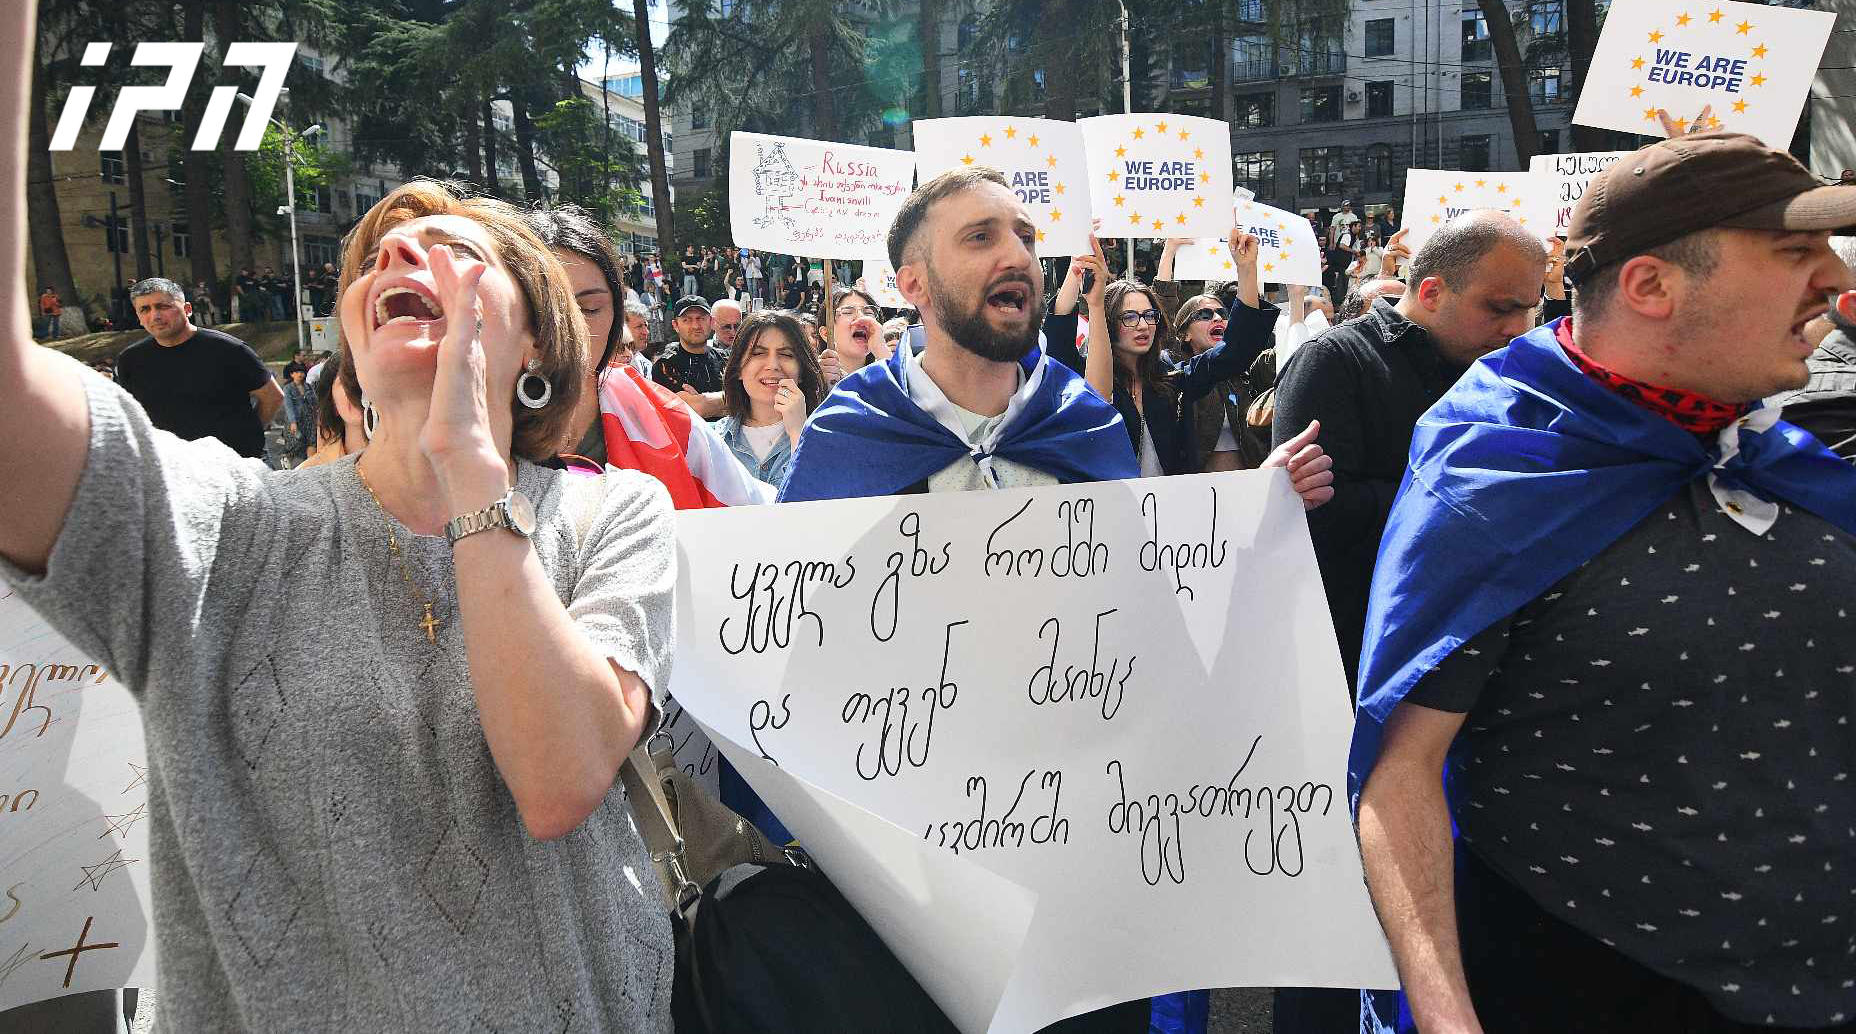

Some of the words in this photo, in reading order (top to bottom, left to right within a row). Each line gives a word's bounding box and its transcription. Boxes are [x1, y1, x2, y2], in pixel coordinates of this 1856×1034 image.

[1655, 48, 1691, 68] WE
[1695, 55, 1747, 76] ARE
[1648, 66, 1742, 93] EUROPE
[823, 151, 877, 177] Russia
[1125, 161, 1153, 175] WE
[1159, 161, 1194, 175] ARE
[1012, 171, 1049, 187] ARE
[1125, 176, 1195, 191] EUROPE
[1015, 188, 1051, 204] OPE
[1249, 226, 1279, 239] ARE
[719, 555, 856, 655] ყველა
[870, 512, 952, 643] გზა
[984, 497, 1109, 577] რომში
[1139, 486, 1228, 601] მიდის
[749, 693, 791, 767] და
[841, 619, 969, 781] თქვენ
[1028, 608, 1137, 720] მაინც
[1107, 734, 1333, 886] მიგვათრევთ
